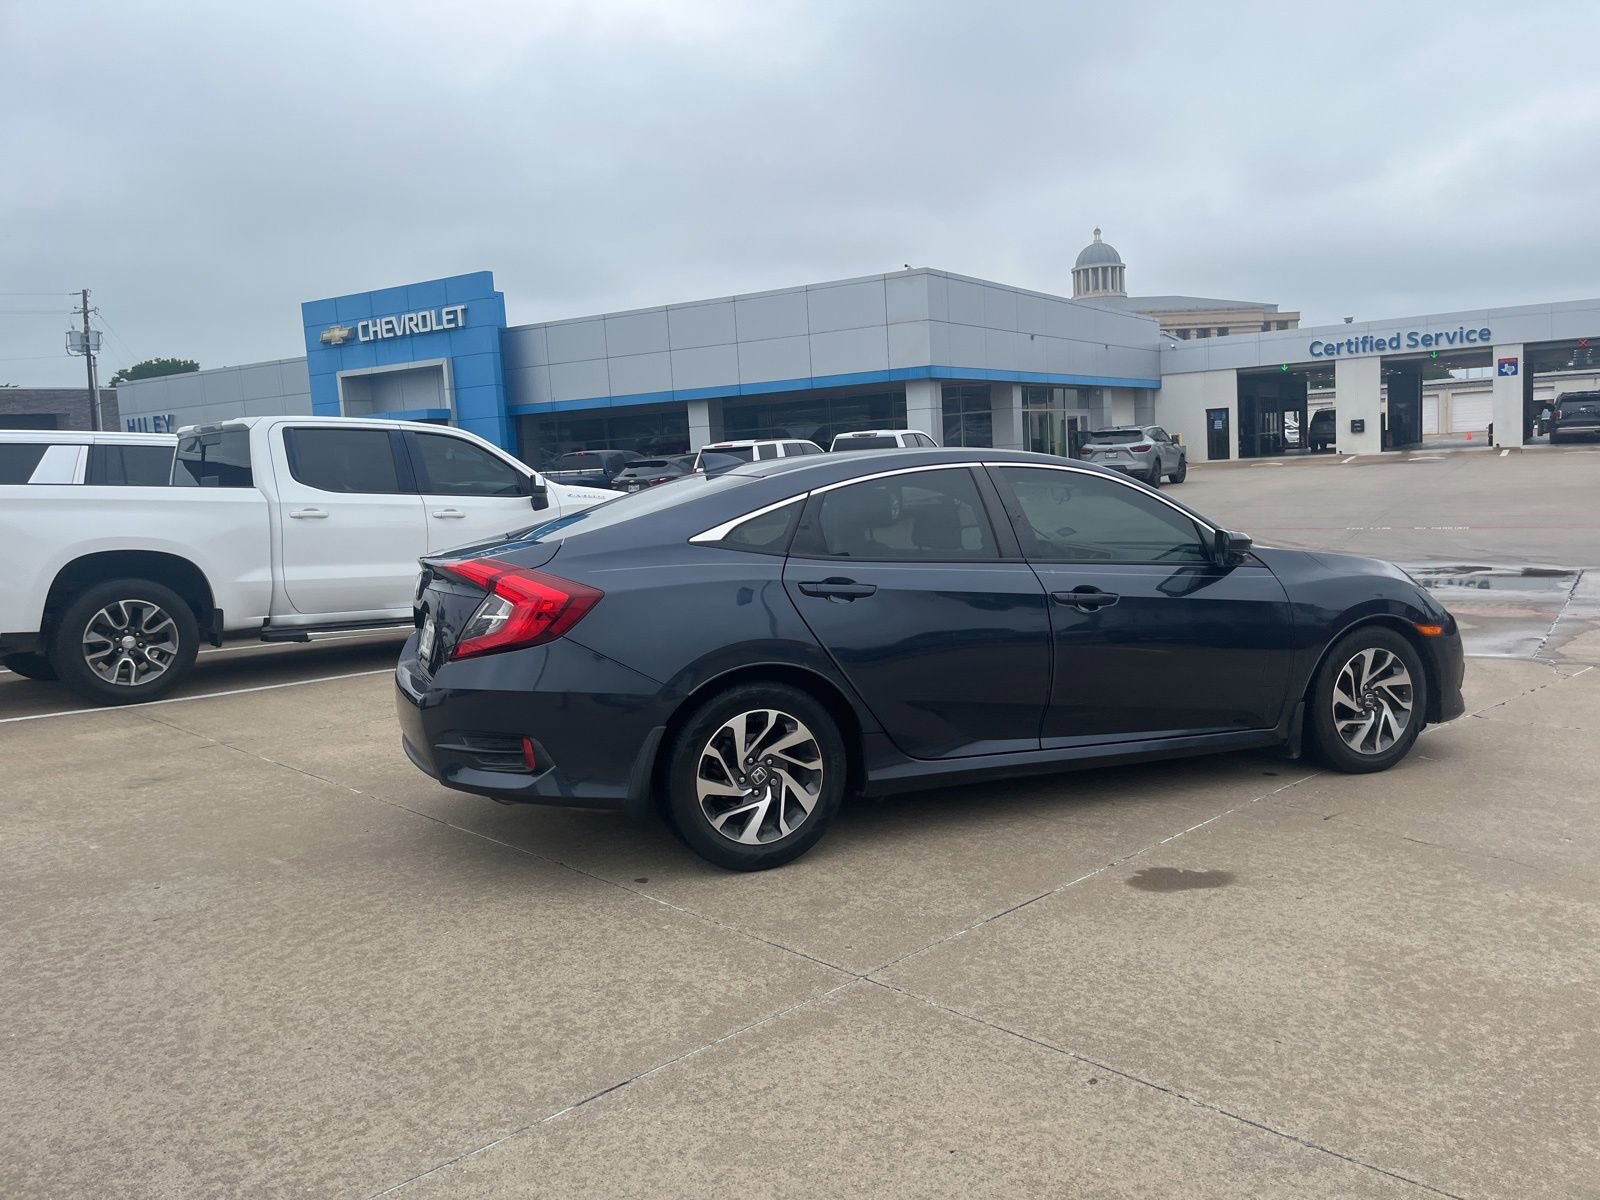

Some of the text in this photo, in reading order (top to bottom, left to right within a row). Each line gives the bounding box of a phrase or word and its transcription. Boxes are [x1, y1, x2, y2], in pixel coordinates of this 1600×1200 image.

[357, 304, 467, 342] CHEVROLET
[1309, 326, 1492, 357] Certified Service
[126, 414, 174, 433] HILEY
